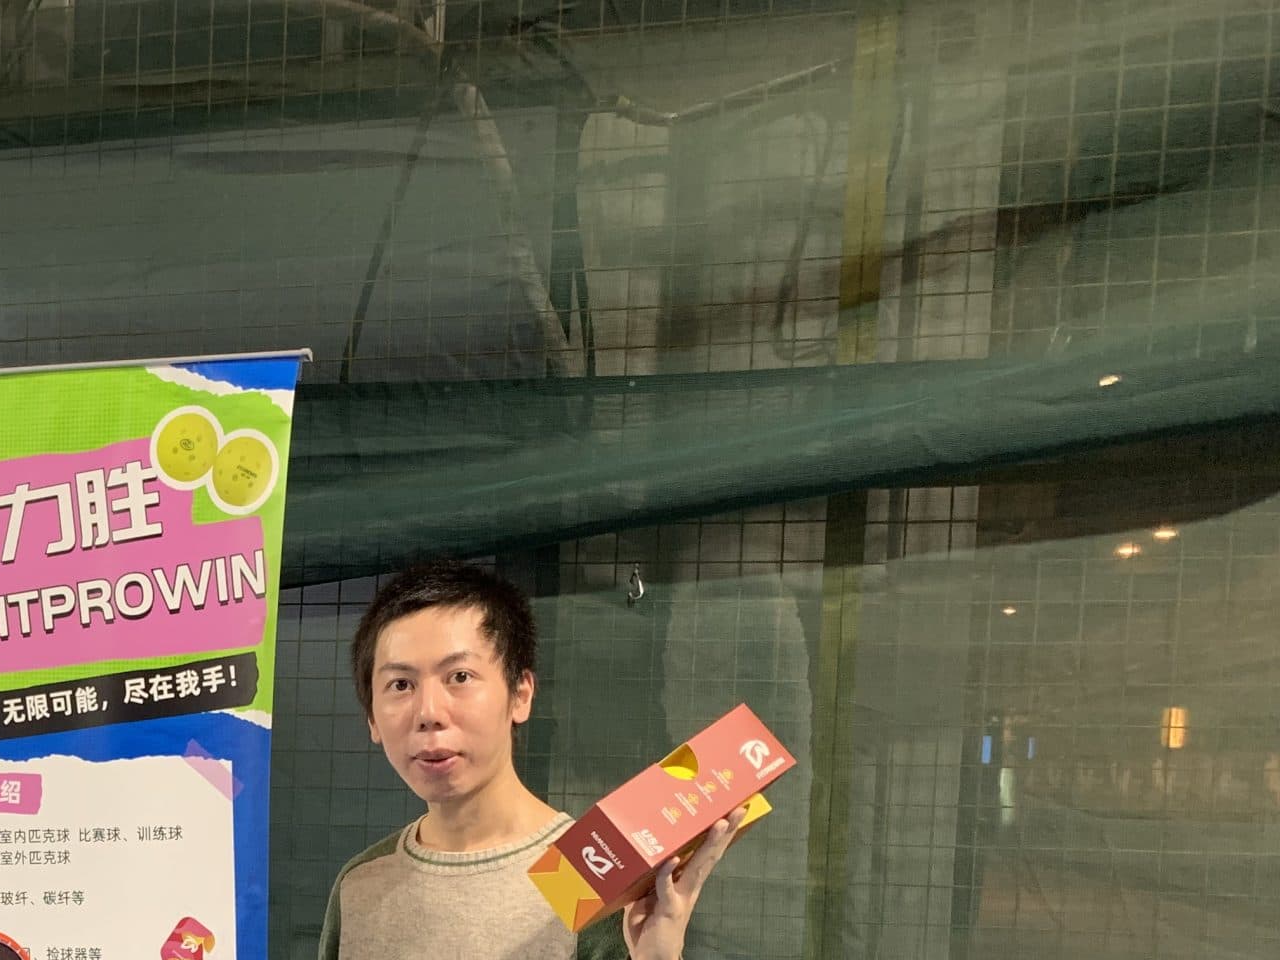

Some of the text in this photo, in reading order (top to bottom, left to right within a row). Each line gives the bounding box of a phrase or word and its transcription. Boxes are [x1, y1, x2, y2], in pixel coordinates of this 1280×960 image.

[2, 664, 240, 726] 无限可能，尽在我手！
[0, 825, 183, 845] 室内匹克球 比赛球、训练球
[0, 850, 71, 866] 室外匹克球
[0, 889, 85, 907] 玻纤、碳纤等
